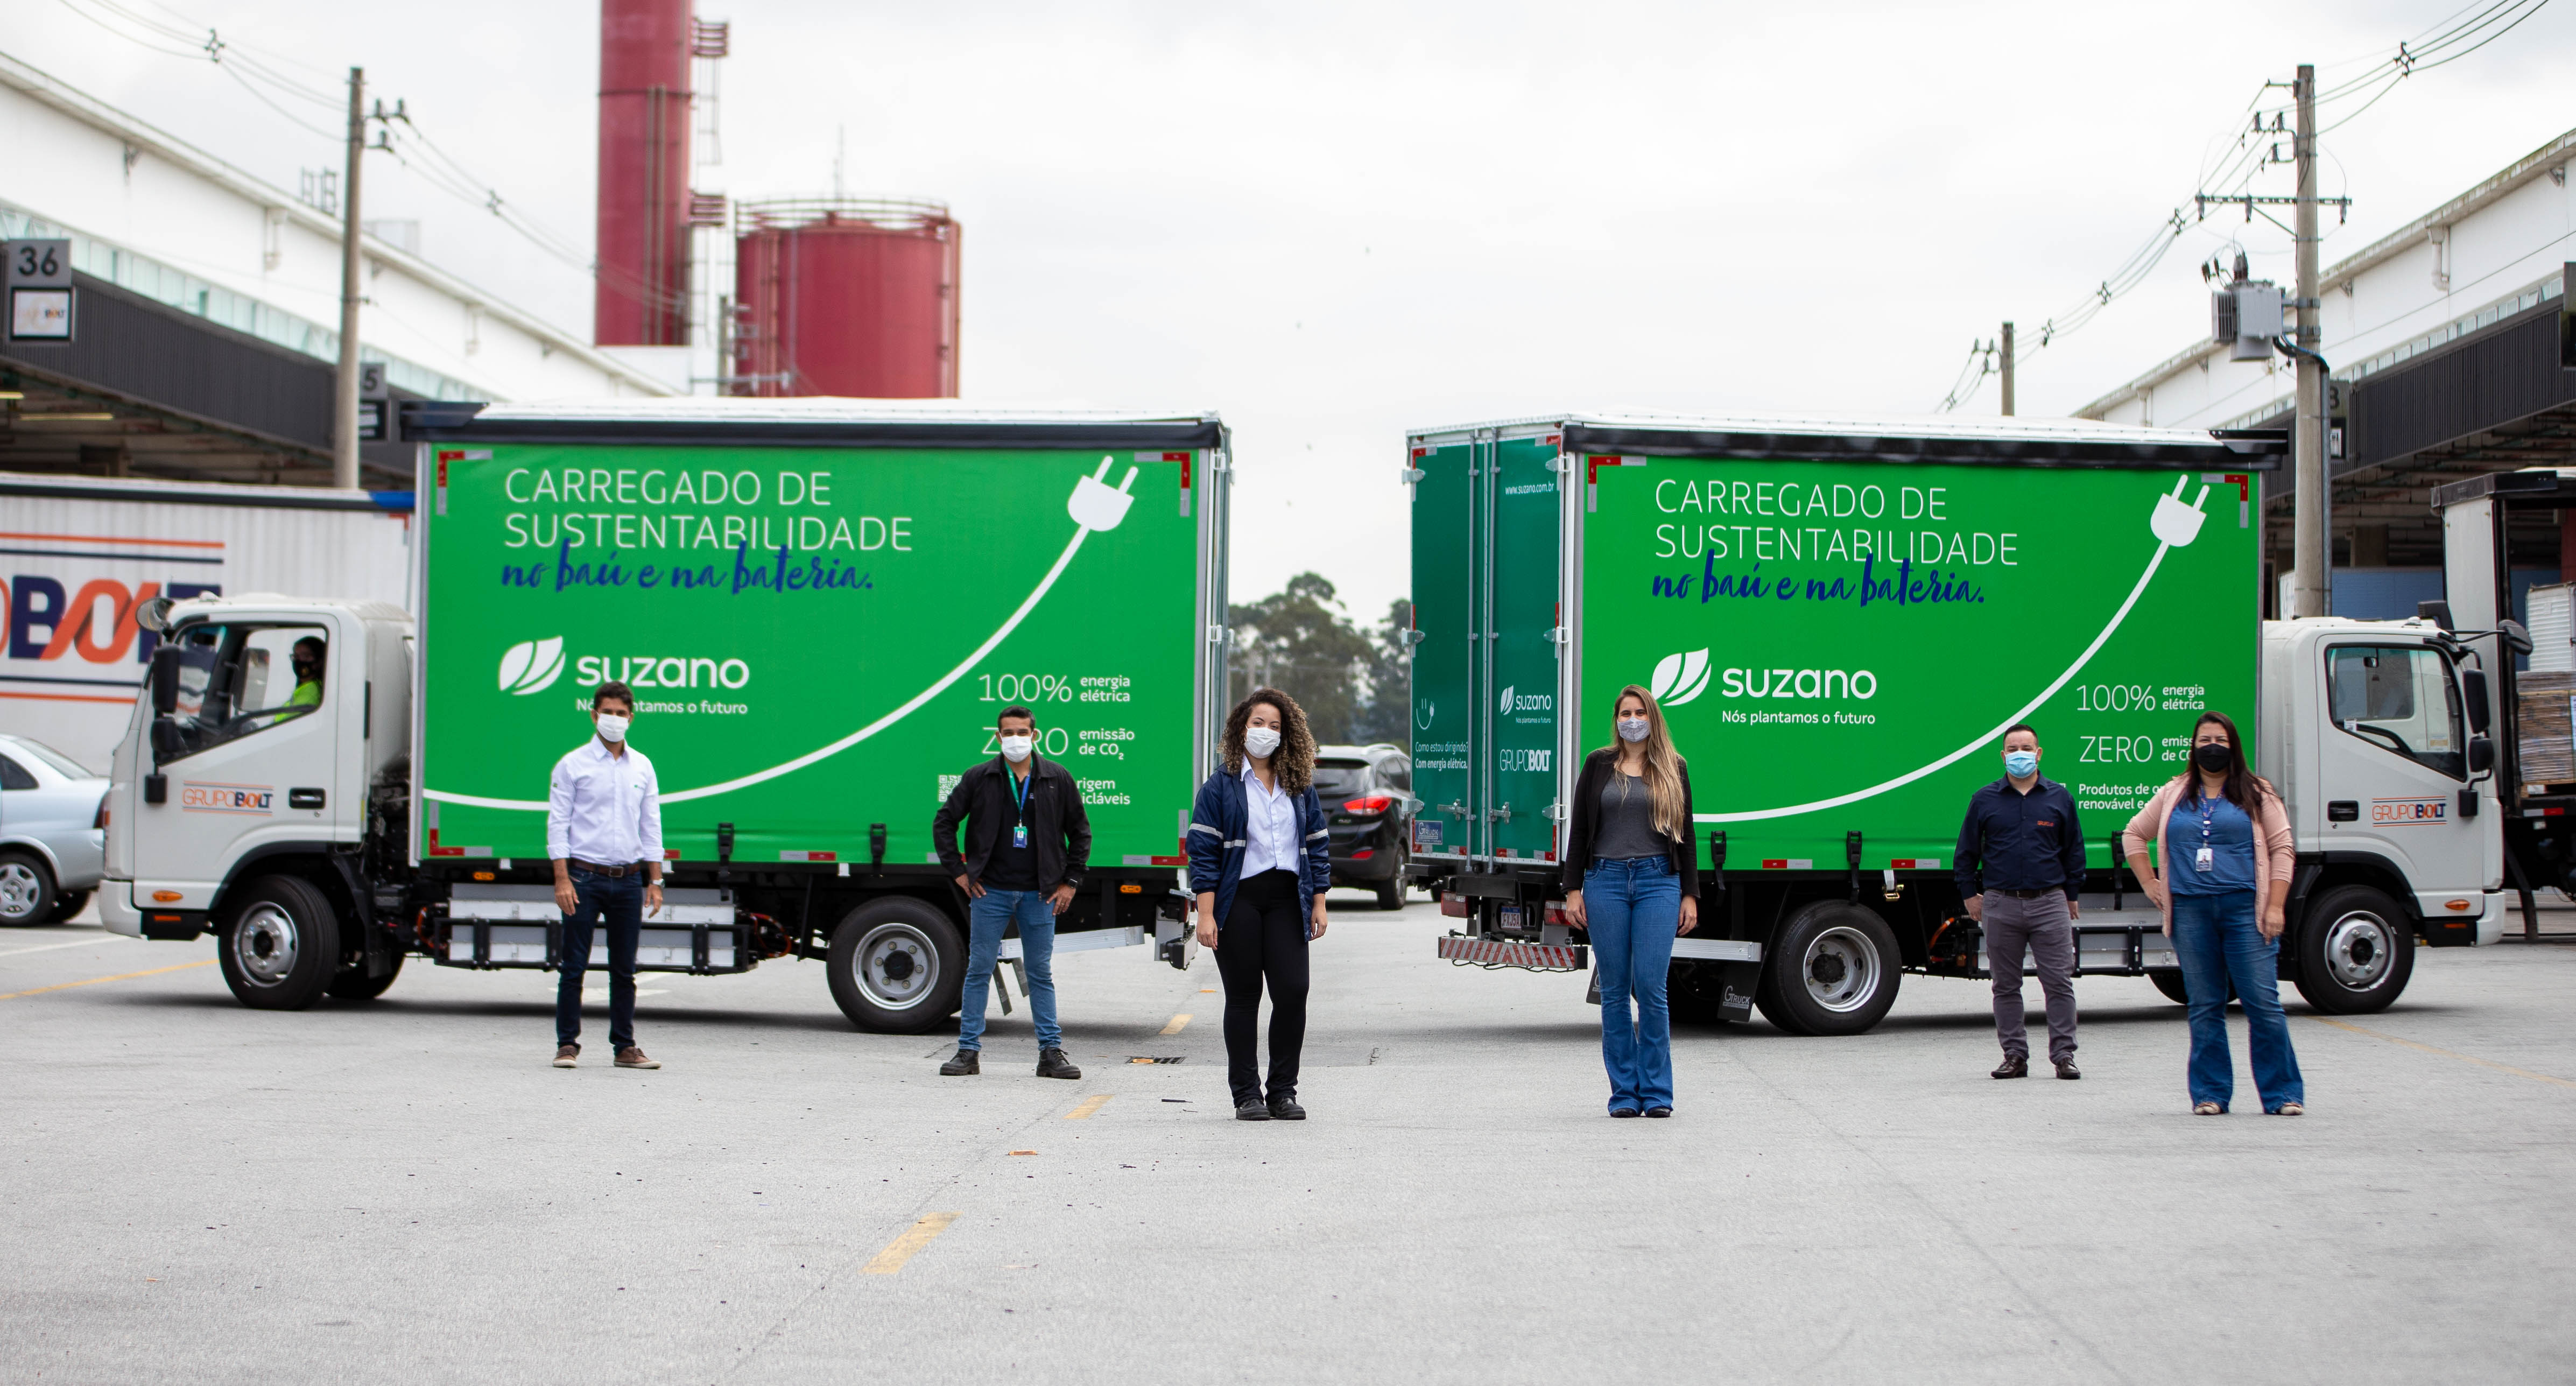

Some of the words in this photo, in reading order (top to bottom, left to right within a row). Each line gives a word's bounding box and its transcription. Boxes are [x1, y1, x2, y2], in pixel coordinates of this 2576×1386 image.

[18, 245, 59, 277] 36
[363, 368, 378, 392] 5
[506, 468, 761, 505] CARREGADO
[779, 472, 831, 506] DE
[1505, 481, 1554, 495] www.suzano.com.br
[1656, 479, 1885, 518] CARREGADO
[1902, 487, 1947, 520] DE
[505, 513, 912, 551] SUSTENTABILIDADE
[1656, 524, 2018, 565] SUSTENTABILIDADE
[502, 562, 550, 588] no
[556, 538, 632, 593] baú
[638, 565, 664, 588] e
[671, 565, 728, 589] na
[732, 540, 873, 595] bateria.
[1652, 574, 1698, 599] no
[1701, 548, 1771, 604] baú
[1776, 578, 1800, 601] e
[1806, 578, 1856, 601] na
[1860, 553, 1984, 608] bateria.
[576, 656, 750, 689] suzano
[979, 674, 1072, 702] 100%
[1080, 674, 1131, 690] energia
[1722, 668, 1877, 700] suzano
[1080, 689, 1131, 702] elétrica
[2077, 685, 2156, 712] 100%
[2162, 684, 2205, 699] energia
[576, 698, 594, 712] Nó
[687, 703, 698, 713] o
[701, 700, 749, 714] futuro
[1516, 694, 1552, 711] suzano
[2162, 698, 2205, 710] elétrica
[1723, 709, 1747, 723] Nós
[1750, 710, 1819, 726] plantamos
[1822, 714, 1831, 724] o
[1834, 710, 1876, 725] futuro
[982, 727, 1069, 756] ZRO
[1079, 728, 1135, 741] emissão
[2162, 735, 2193, 747] emiss
[1079, 743, 1096, 755] de
[1415, 741, 1430, 752] Como
[1430, 742, 1444, 752] estou
[1445, 741, 1468, 755] dirigindo?
[2079, 736, 2153, 763] ZERO
[2162, 749, 2176, 762] de
[1415, 758, 1426, 769] Com
[1427, 757, 1447, 772] energia
[1447, 757, 1468, 769] elétrica.
[1500, 749, 1551, 772] GRUPOBOLT
[1076, 777, 1116, 792] rigem
[2079, 783, 2132, 796] Produtos
[2135, 783, 2150, 795] de
[183, 788, 273, 809] GRUPOBOLT
[1082, 792, 1131, 805] icláveis
[2079, 798, 2135, 810] renovável
[2371, 803, 2446, 821] GRUPOBOLT
[1503, 913, 1521, 926] FXJ5A
[1725, 985, 1751, 1005] GTRUCK
